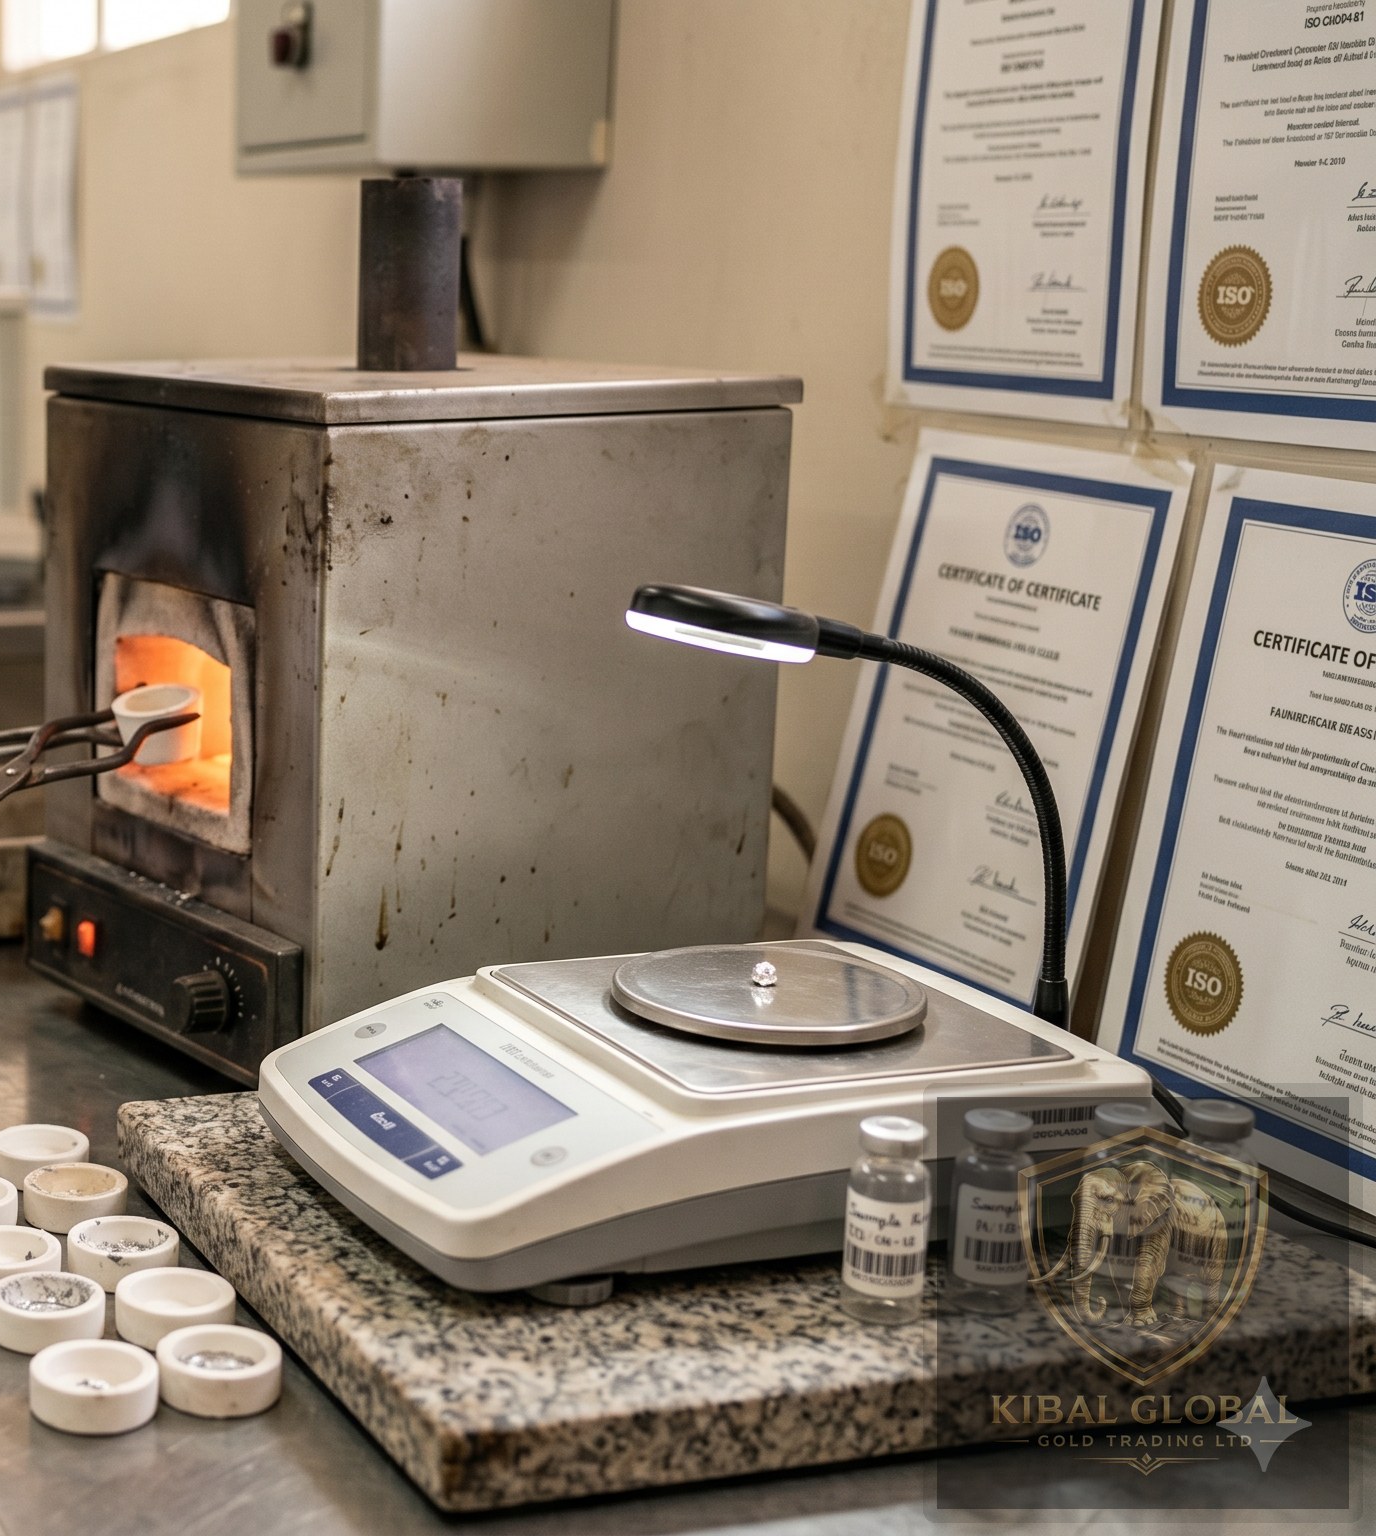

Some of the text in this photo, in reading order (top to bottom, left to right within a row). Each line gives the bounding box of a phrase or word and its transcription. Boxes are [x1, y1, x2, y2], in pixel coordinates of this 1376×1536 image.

[1304, 17, 1321, 29] ISO
[1216, 285, 1254, 305] ISO
[1013, 524, 1042, 544] ISO
[938, 562, 1102, 612] CERTIFICATE OF CERTIFICATE
[1253, 630, 1376, 670] CERTIFICATE OF
[868, 840, 899, 867] ISO
[1184, 967, 1222, 996] ISO
